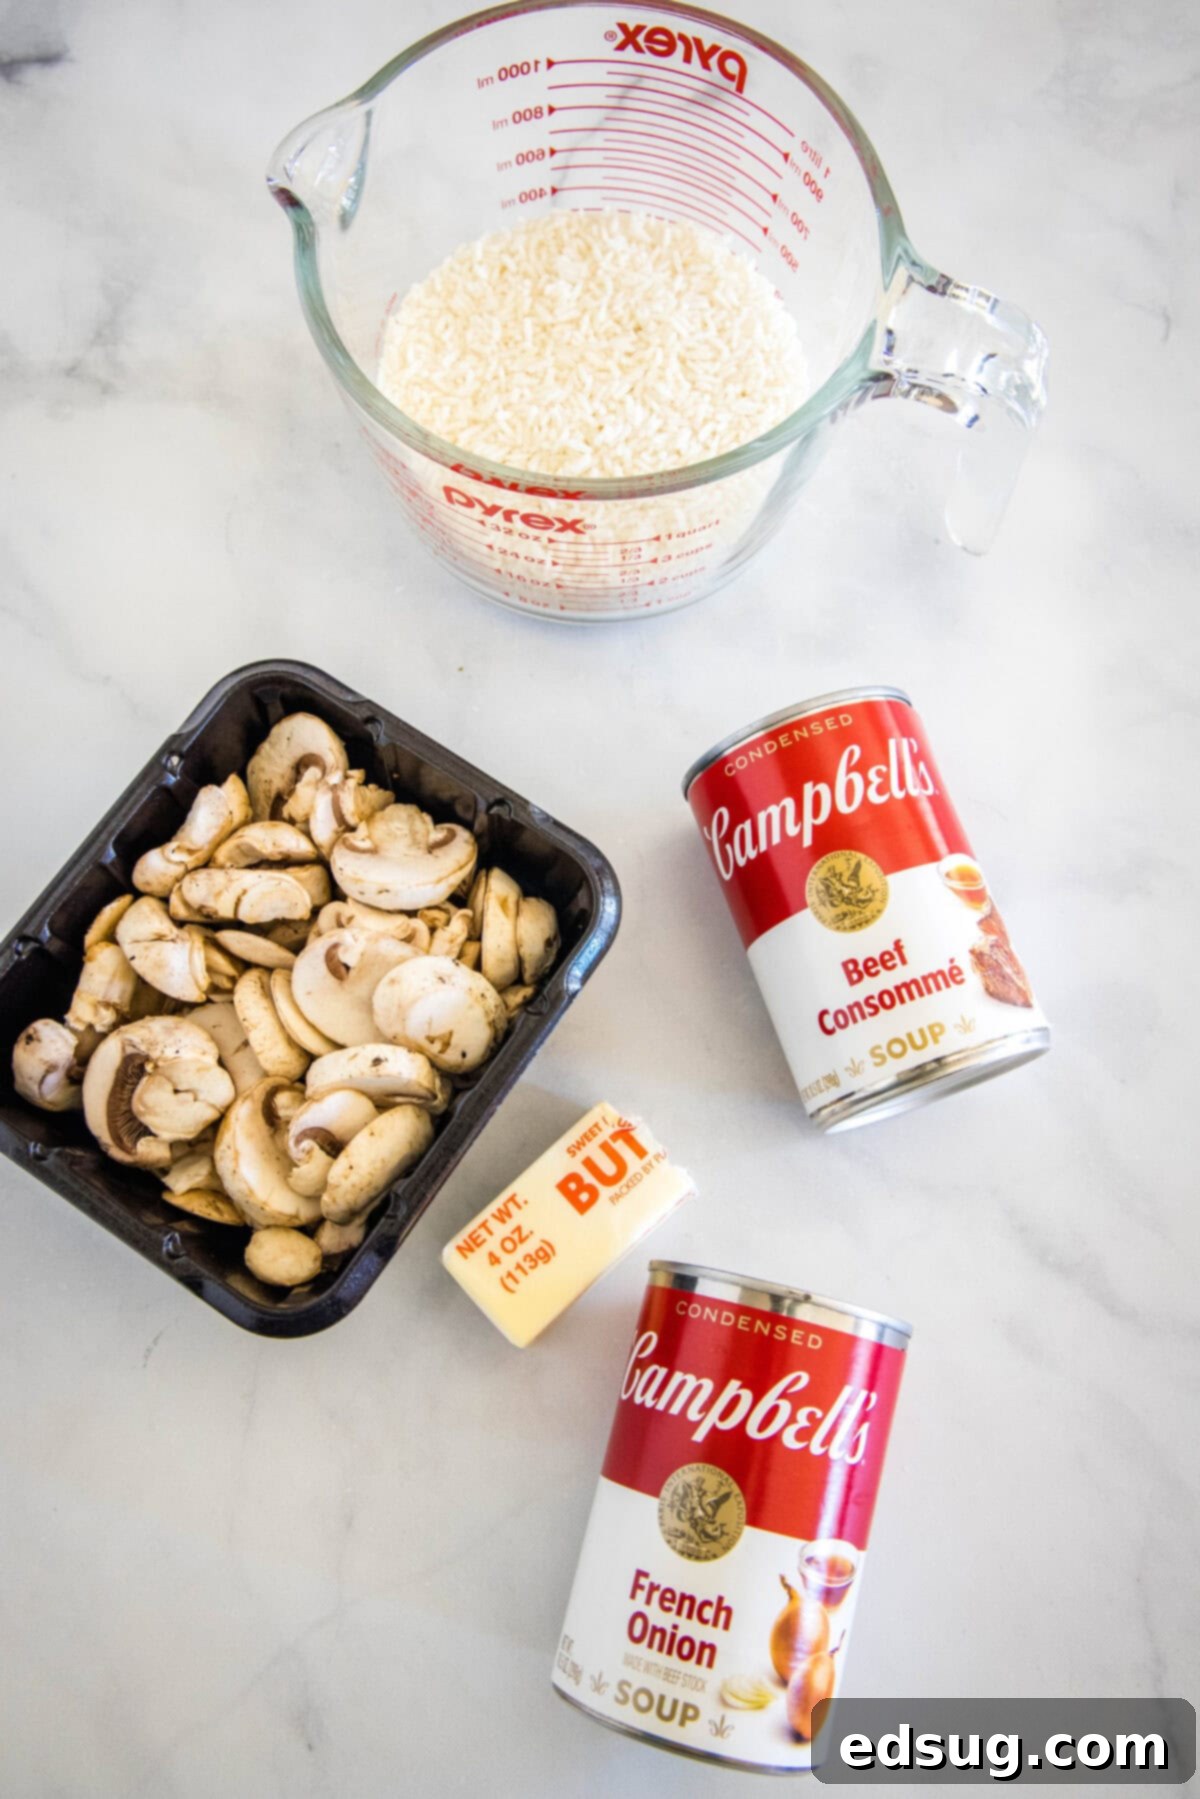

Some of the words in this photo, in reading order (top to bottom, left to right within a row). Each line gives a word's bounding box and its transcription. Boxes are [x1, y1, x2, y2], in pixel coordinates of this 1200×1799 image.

[723, 713, 854, 777] CONDENSED
[704, 738, 935, 883] Campbell's
[841, 939, 909, 987] Beef
[817, 958, 966, 1037] Consommé
[870, 1021, 946, 1069] SOUP
[566, 1122, 602, 1158] SWEET
[609, 1170, 644, 1206] PACKED
[641, 1159, 656, 1177] BY
[455, 1218, 495, 1259] NET
[491, 1192, 529, 1226] WT.
[487, 1251, 501, 1268] 4
[500, 1222, 534, 1255] OZ.
[499, 1239, 556, 1294] (113g)
[675, 1300, 824, 1350] CONDENSED
[620, 1330, 879, 1466] Campbell's
[629, 1568, 735, 1632] French
[626, 1610, 718, 1669] Onion
[614, 1678, 701, 1728] SOUP
